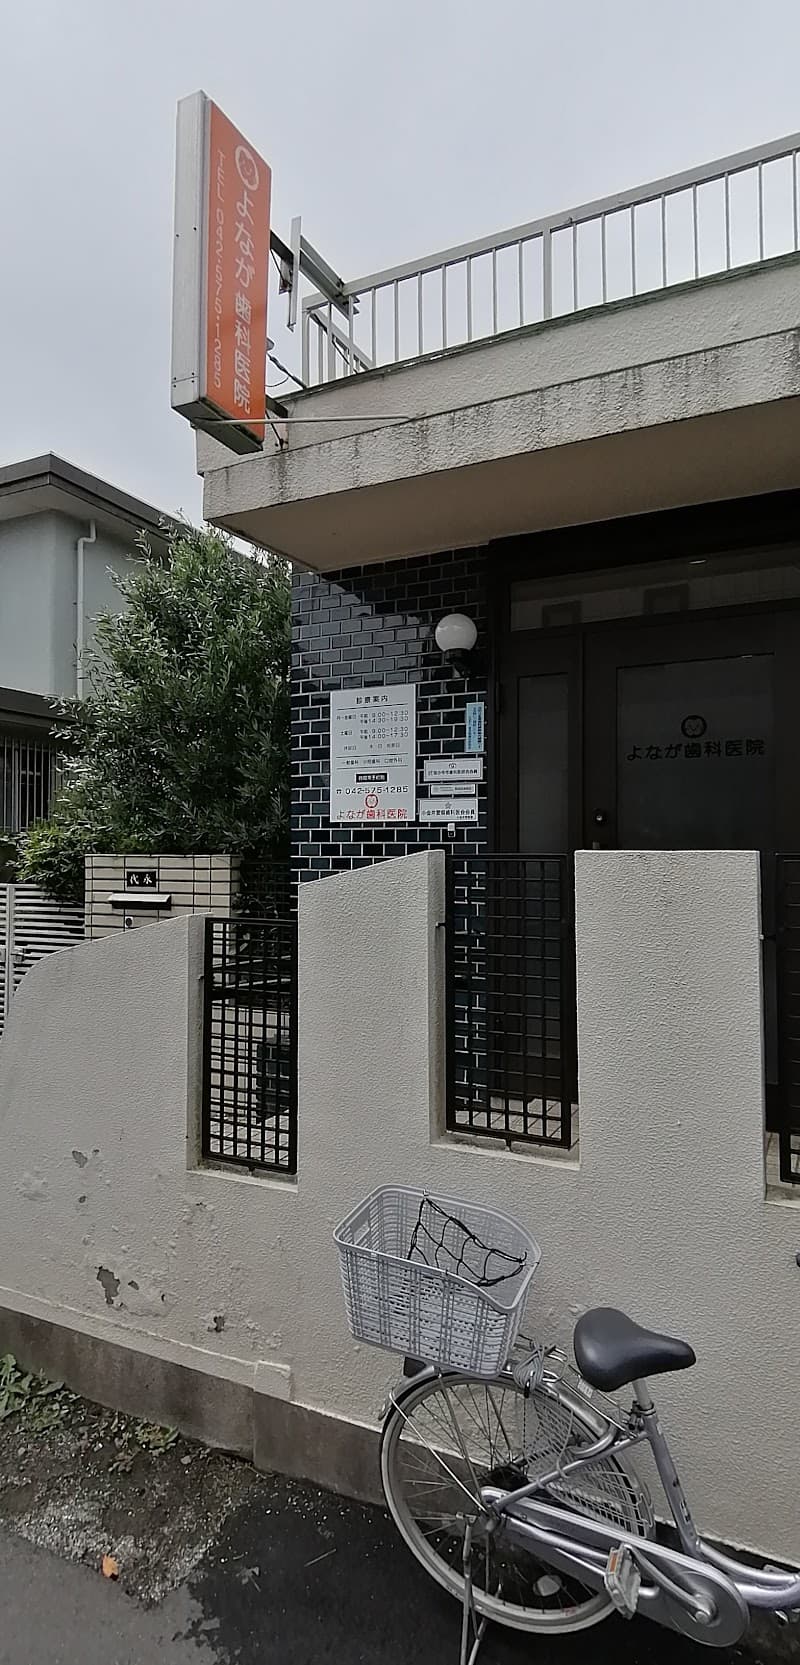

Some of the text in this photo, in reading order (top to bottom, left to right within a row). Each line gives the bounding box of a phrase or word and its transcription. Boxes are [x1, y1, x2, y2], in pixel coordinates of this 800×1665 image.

[216, 149, 226, 202] TEL
[233, 191, 255, 415] よなが歯科医院
[356, 695, 388, 704] 診療案内
[627, 738, 766, 762] よなが歯科医院
[345, 785, 409, 795] 042-575-1285
[336, 808, 408, 820] よなが歯科医院
